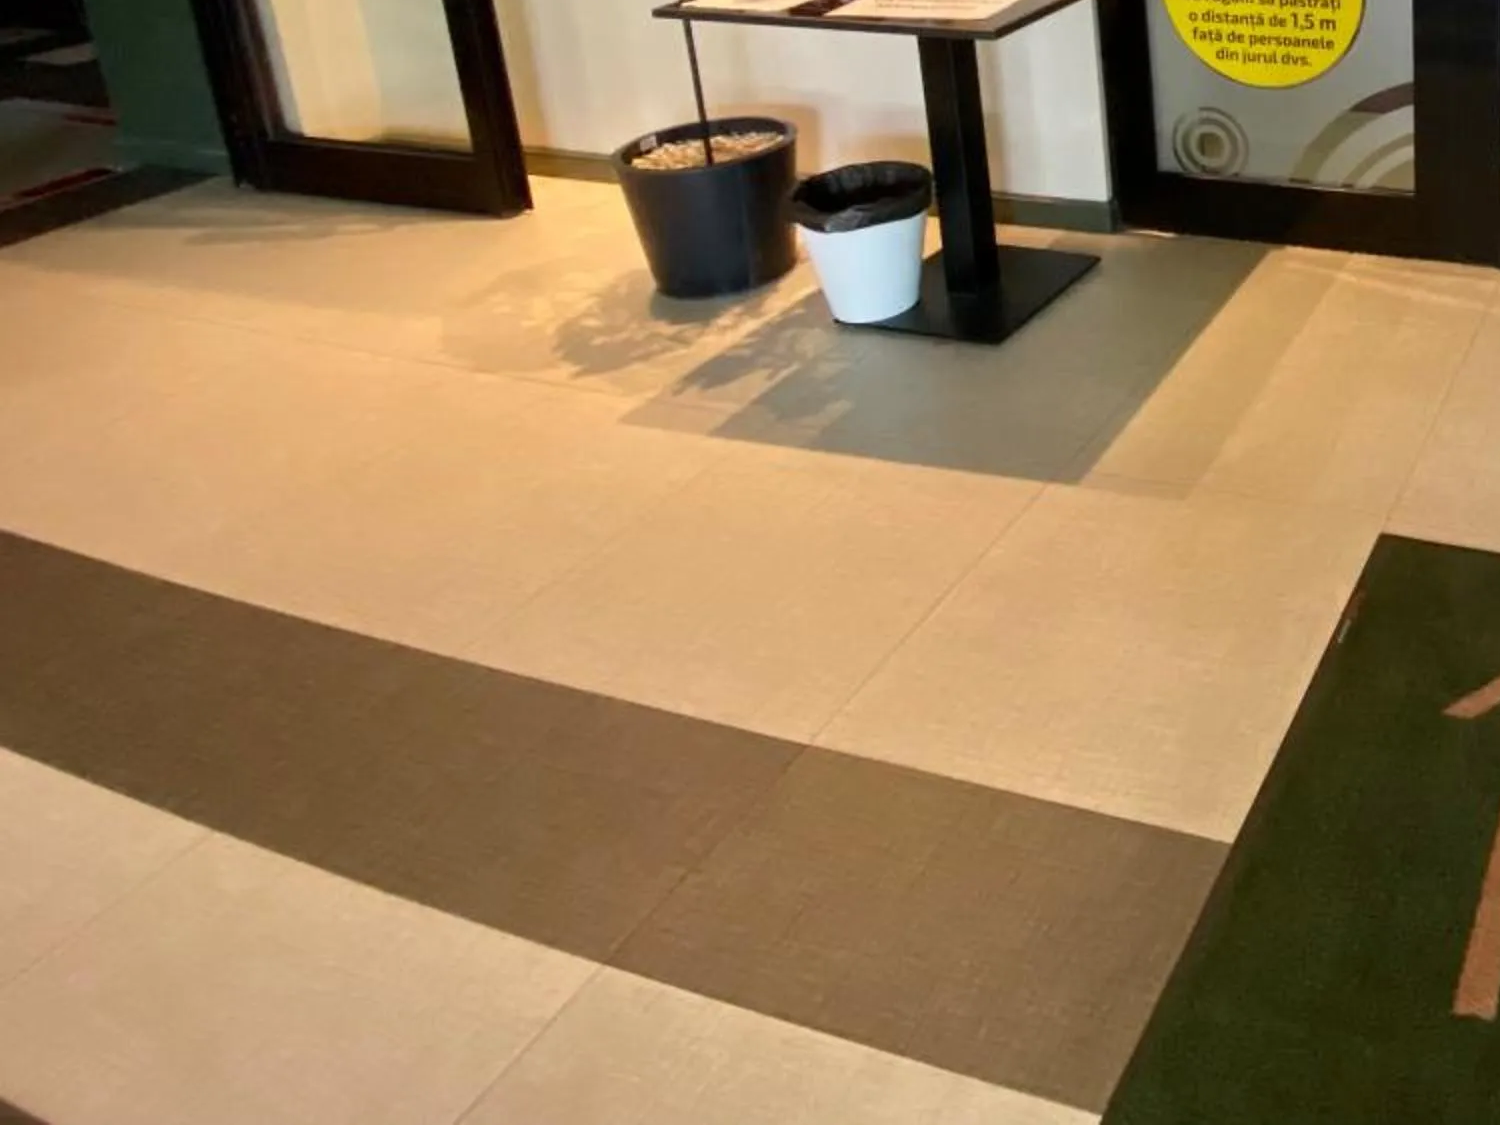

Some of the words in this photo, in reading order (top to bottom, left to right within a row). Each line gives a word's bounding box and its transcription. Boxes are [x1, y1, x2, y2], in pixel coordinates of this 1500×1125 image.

[1188, 11, 1198, 22] o
[1201, 10, 1265, 29] distanță
[1269, 14, 1287, 28] de
[1290, 12, 1315, 31] 1,5
[1319, 18, 1337, 32] m
[1192, 27, 1223, 43] față
[1227, 30, 1245, 44] de
[1249, 33, 1335, 50] persoanele
[1215, 47, 1239, 61] din
[1242, 49, 1278, 64] jurul
[1281, 51, 1313, 66] dvs.
